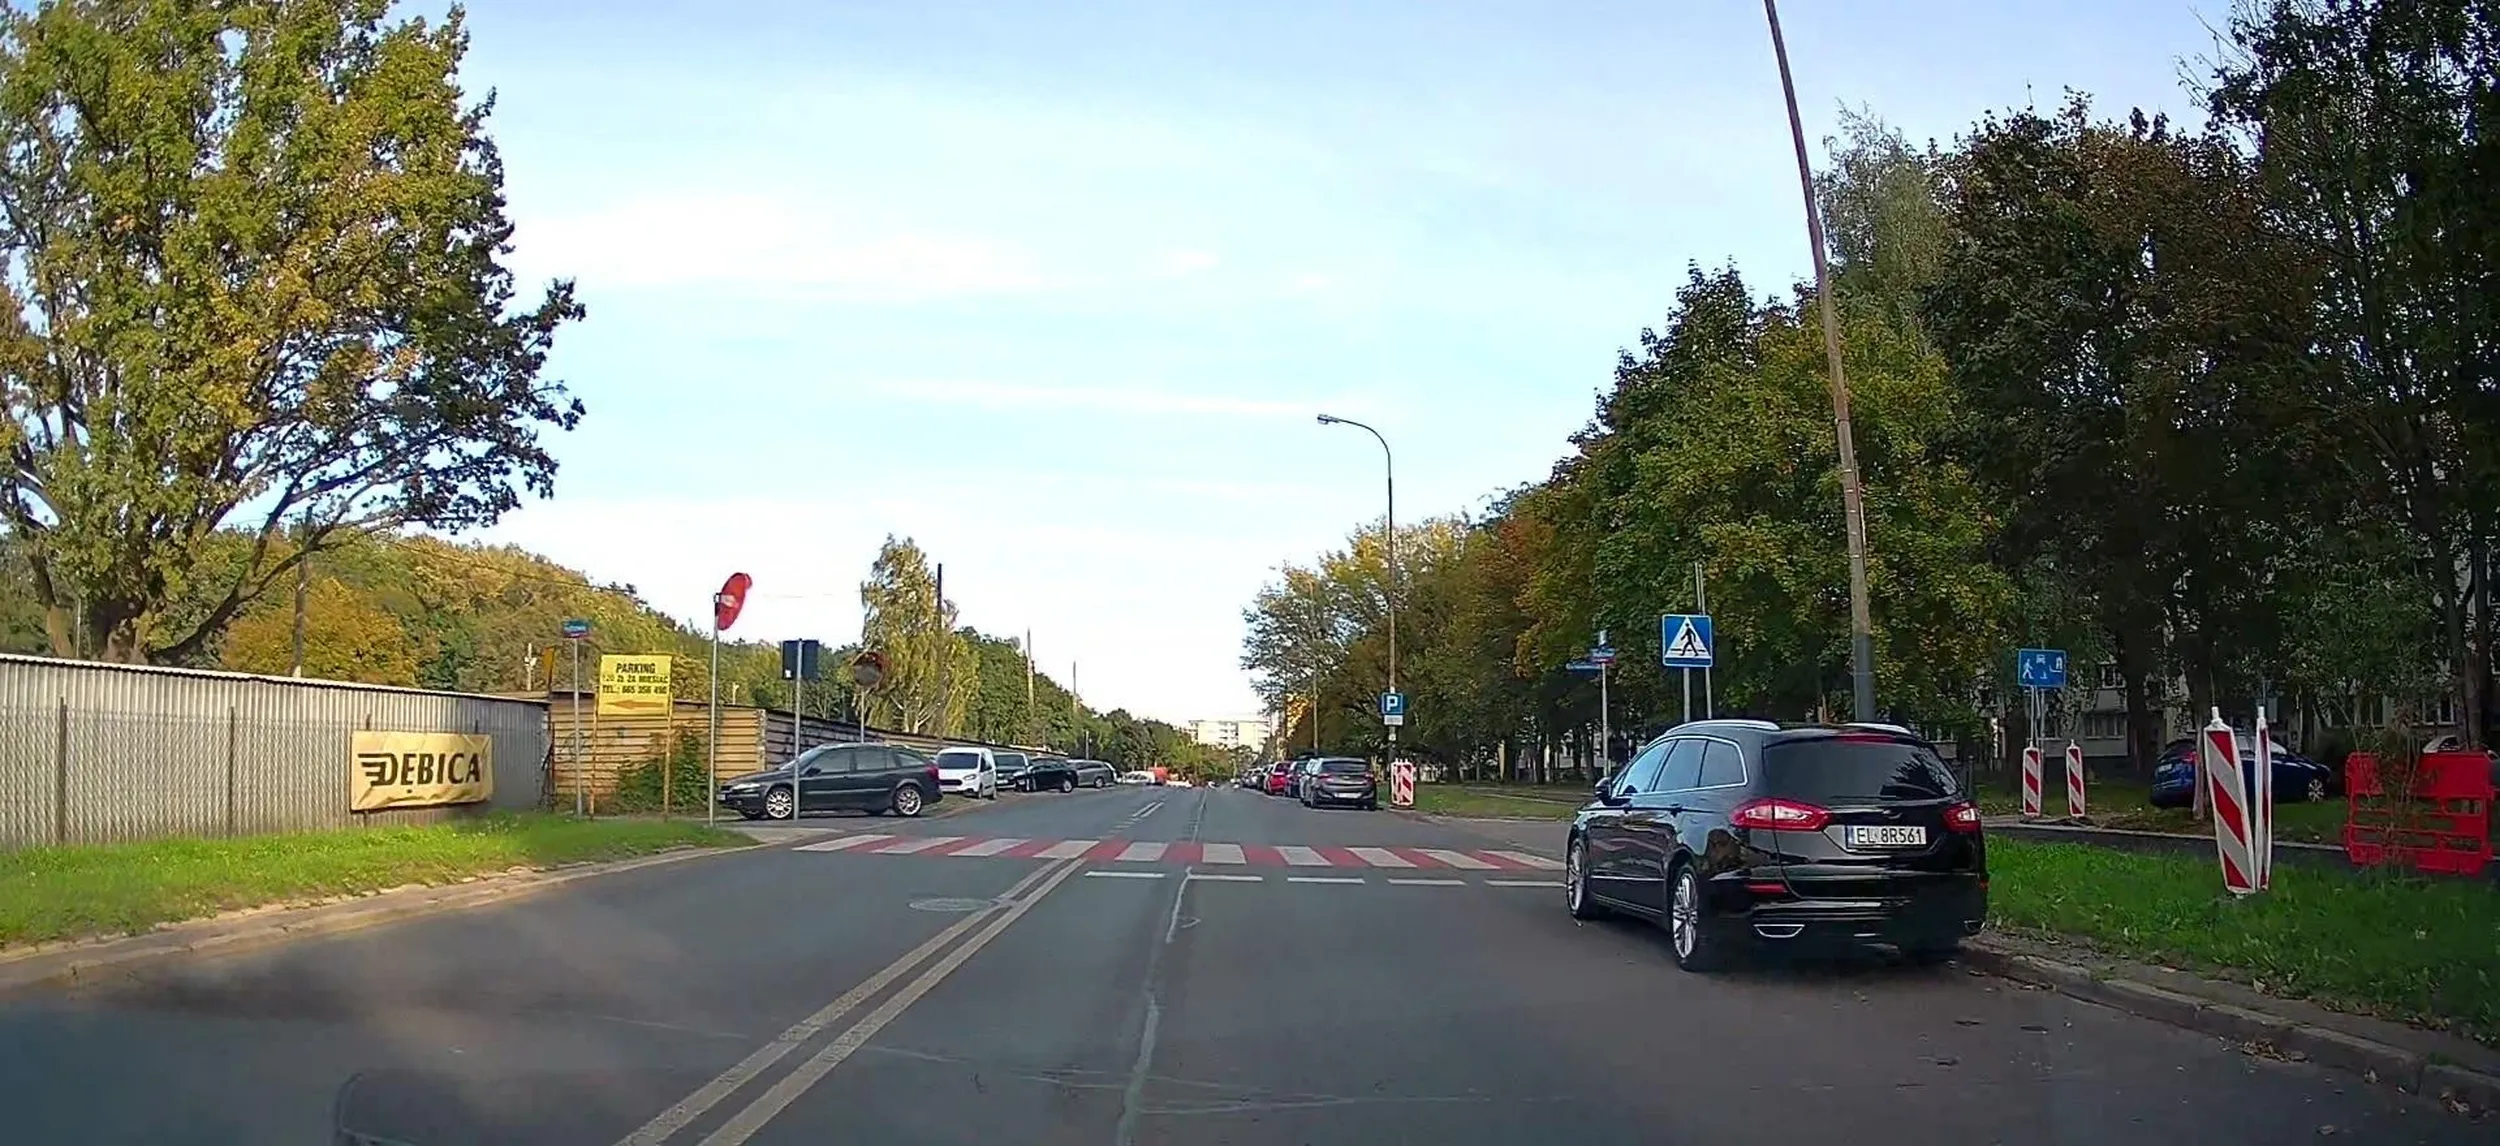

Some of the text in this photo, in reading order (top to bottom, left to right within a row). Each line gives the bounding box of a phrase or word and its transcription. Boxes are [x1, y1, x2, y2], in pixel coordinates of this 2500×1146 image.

[616, 663, 656, 674] PARKING
[1386, 695, 1399, 712] P
[1857, 828, 1921, 843] EL 8R561
